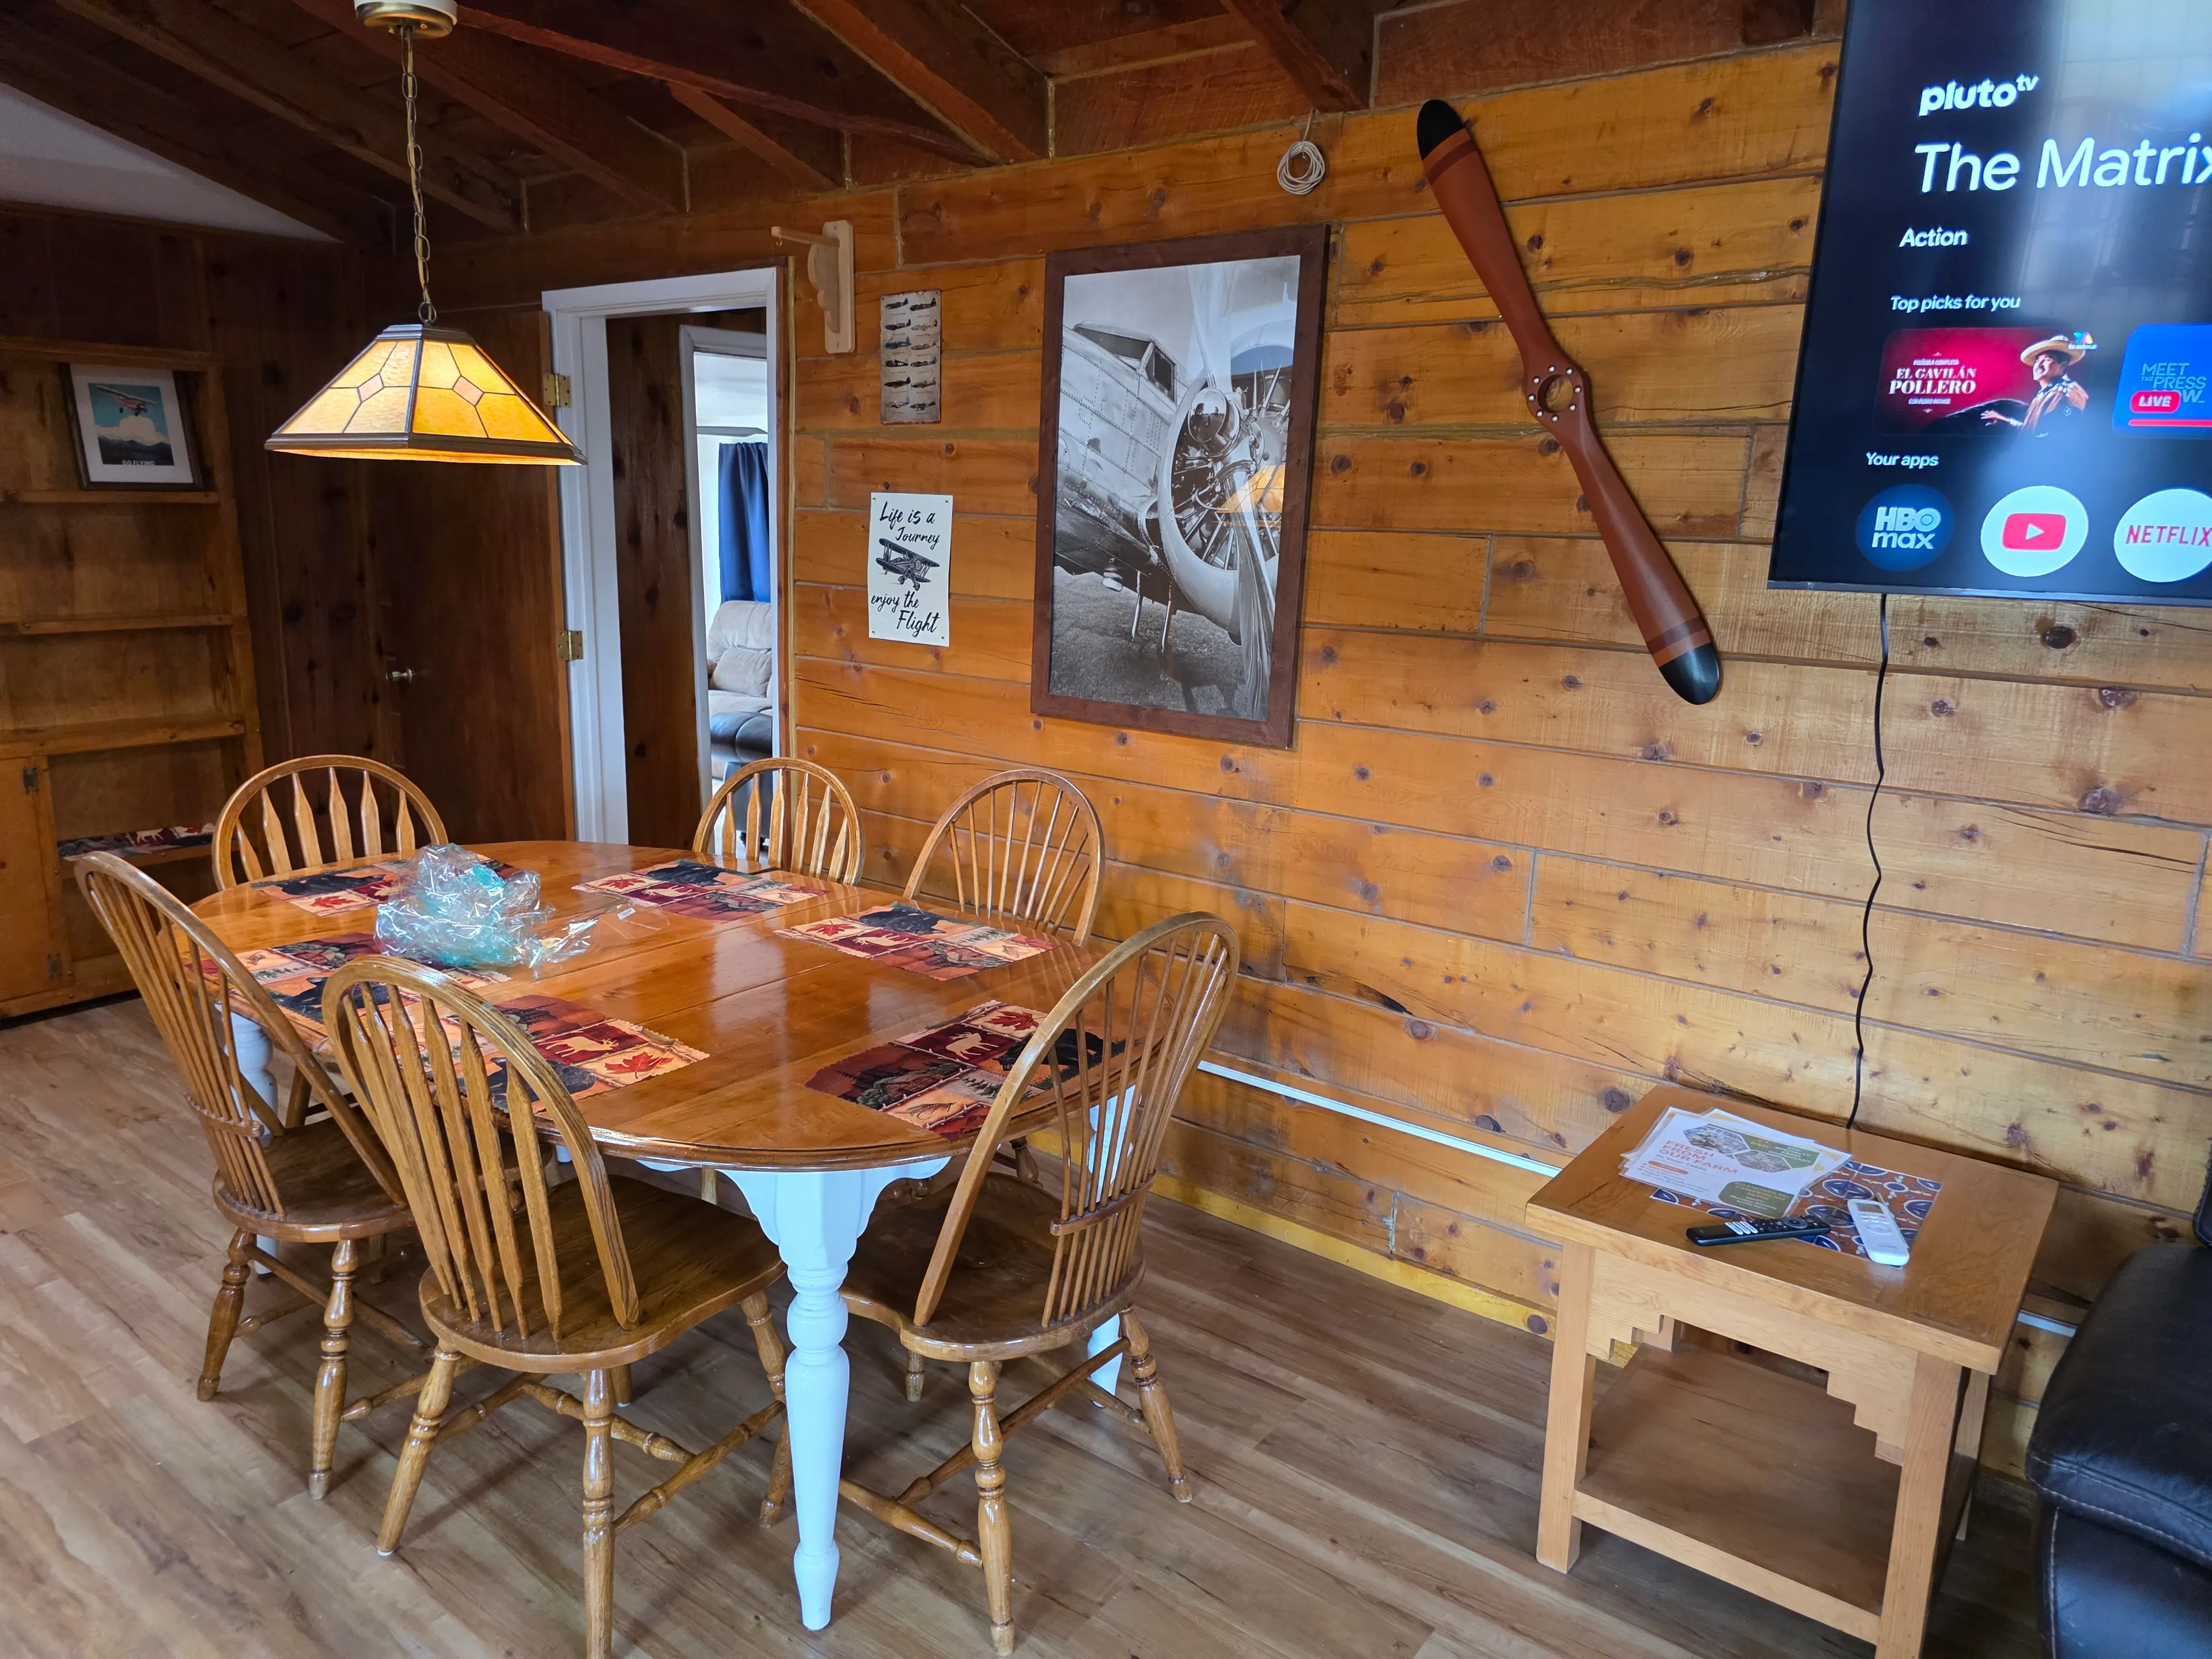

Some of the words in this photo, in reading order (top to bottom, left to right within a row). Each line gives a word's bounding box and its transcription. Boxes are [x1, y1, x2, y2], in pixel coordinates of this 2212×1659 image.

[1914, 142, 2020, 192] The
[1899, 226, 1969, 247] Action
[1891, 295, 1919, 313] Top
[1921, 294, 1963, 313] picks
[1964, 294, 1989, 309] for
[1991, 296, 2021, 312] you
[1896, 368, 1912, 379] EL
[1915, 365, 1977, 379] GAVILÁN
[2141, 363, 2190, 376] MEET
[1888, 380, 1976, 394] POLLERO
[2153, 376, 2207, 389] PRESS
[2138, 395, 2172, 407] LIVE
[1866, 452, 1900, 465] Your
[1901, 455, 1940, 469] apps
[879, 501, 903, 530] Life
[907, 510, 921, 524] is
[926, 512, 935, 524] a
[1874, 506, 1941, 532] HBO
[895, 526, 940, 550] Journey
[1872, 532, 1936, 549] max
[2125, 524, 2212, 547] NETFLIX
[870, 593, 900, 613] enjoy
[903, 590, 919, 608] the
[896, 610, 941, 637] Flight
[1662, 1145, 1706, 1160] FROM
[1666, 1141, 1714, 1157] FRESH
[1660, 1149, 1691, 1161] OUR
[1694, 1159, 1738, 1174] FARM
[1687, 1162, 1707, 1171] Table
